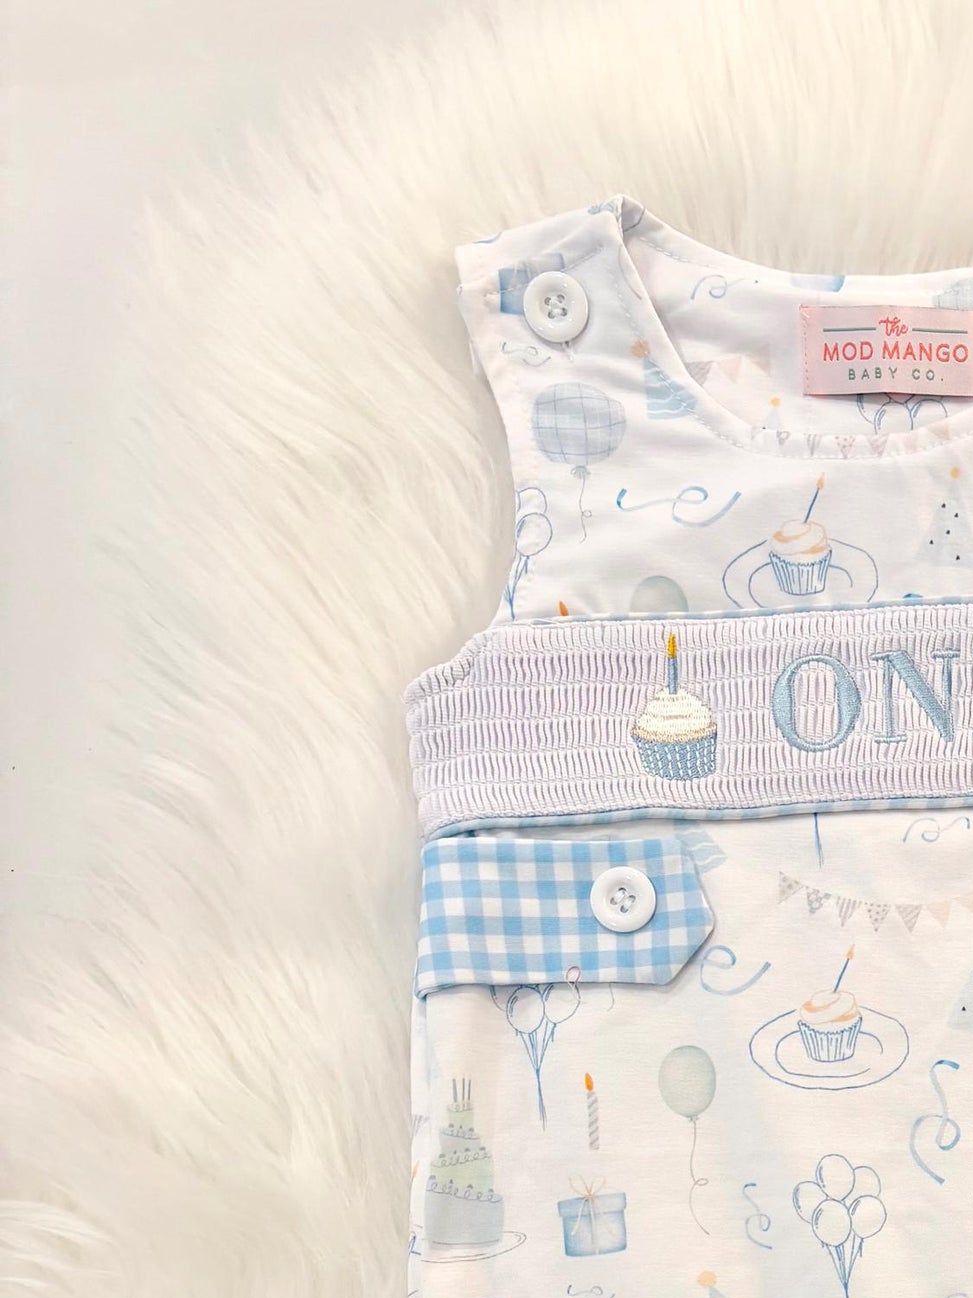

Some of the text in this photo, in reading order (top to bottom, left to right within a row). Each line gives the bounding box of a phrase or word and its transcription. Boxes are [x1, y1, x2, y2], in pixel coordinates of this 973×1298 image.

[878, 316, 909, 336] the
[823, 341, 969, 363] MOD MANGO
[848, 367, 944, 382] BABY CO.
